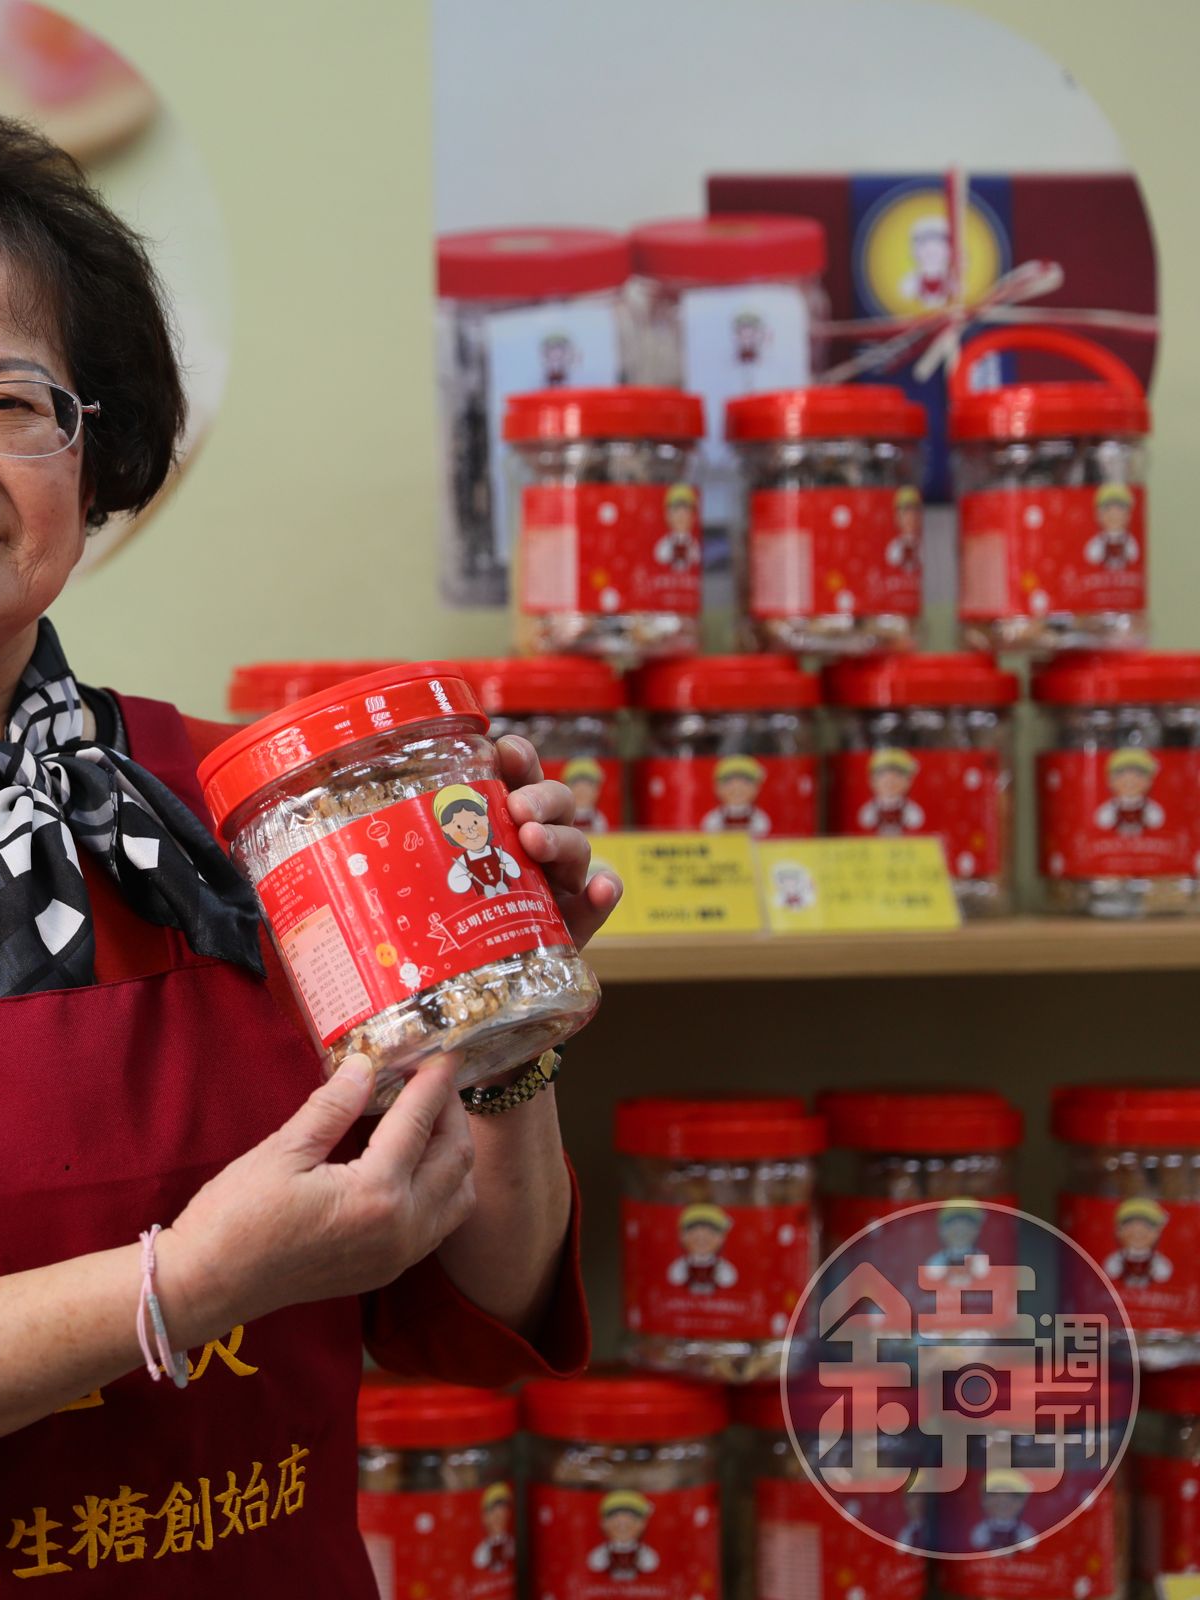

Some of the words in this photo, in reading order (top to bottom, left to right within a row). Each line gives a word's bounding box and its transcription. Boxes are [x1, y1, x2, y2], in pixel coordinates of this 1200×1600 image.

[456, 900, 546, 935] 志明花生糖創始店
